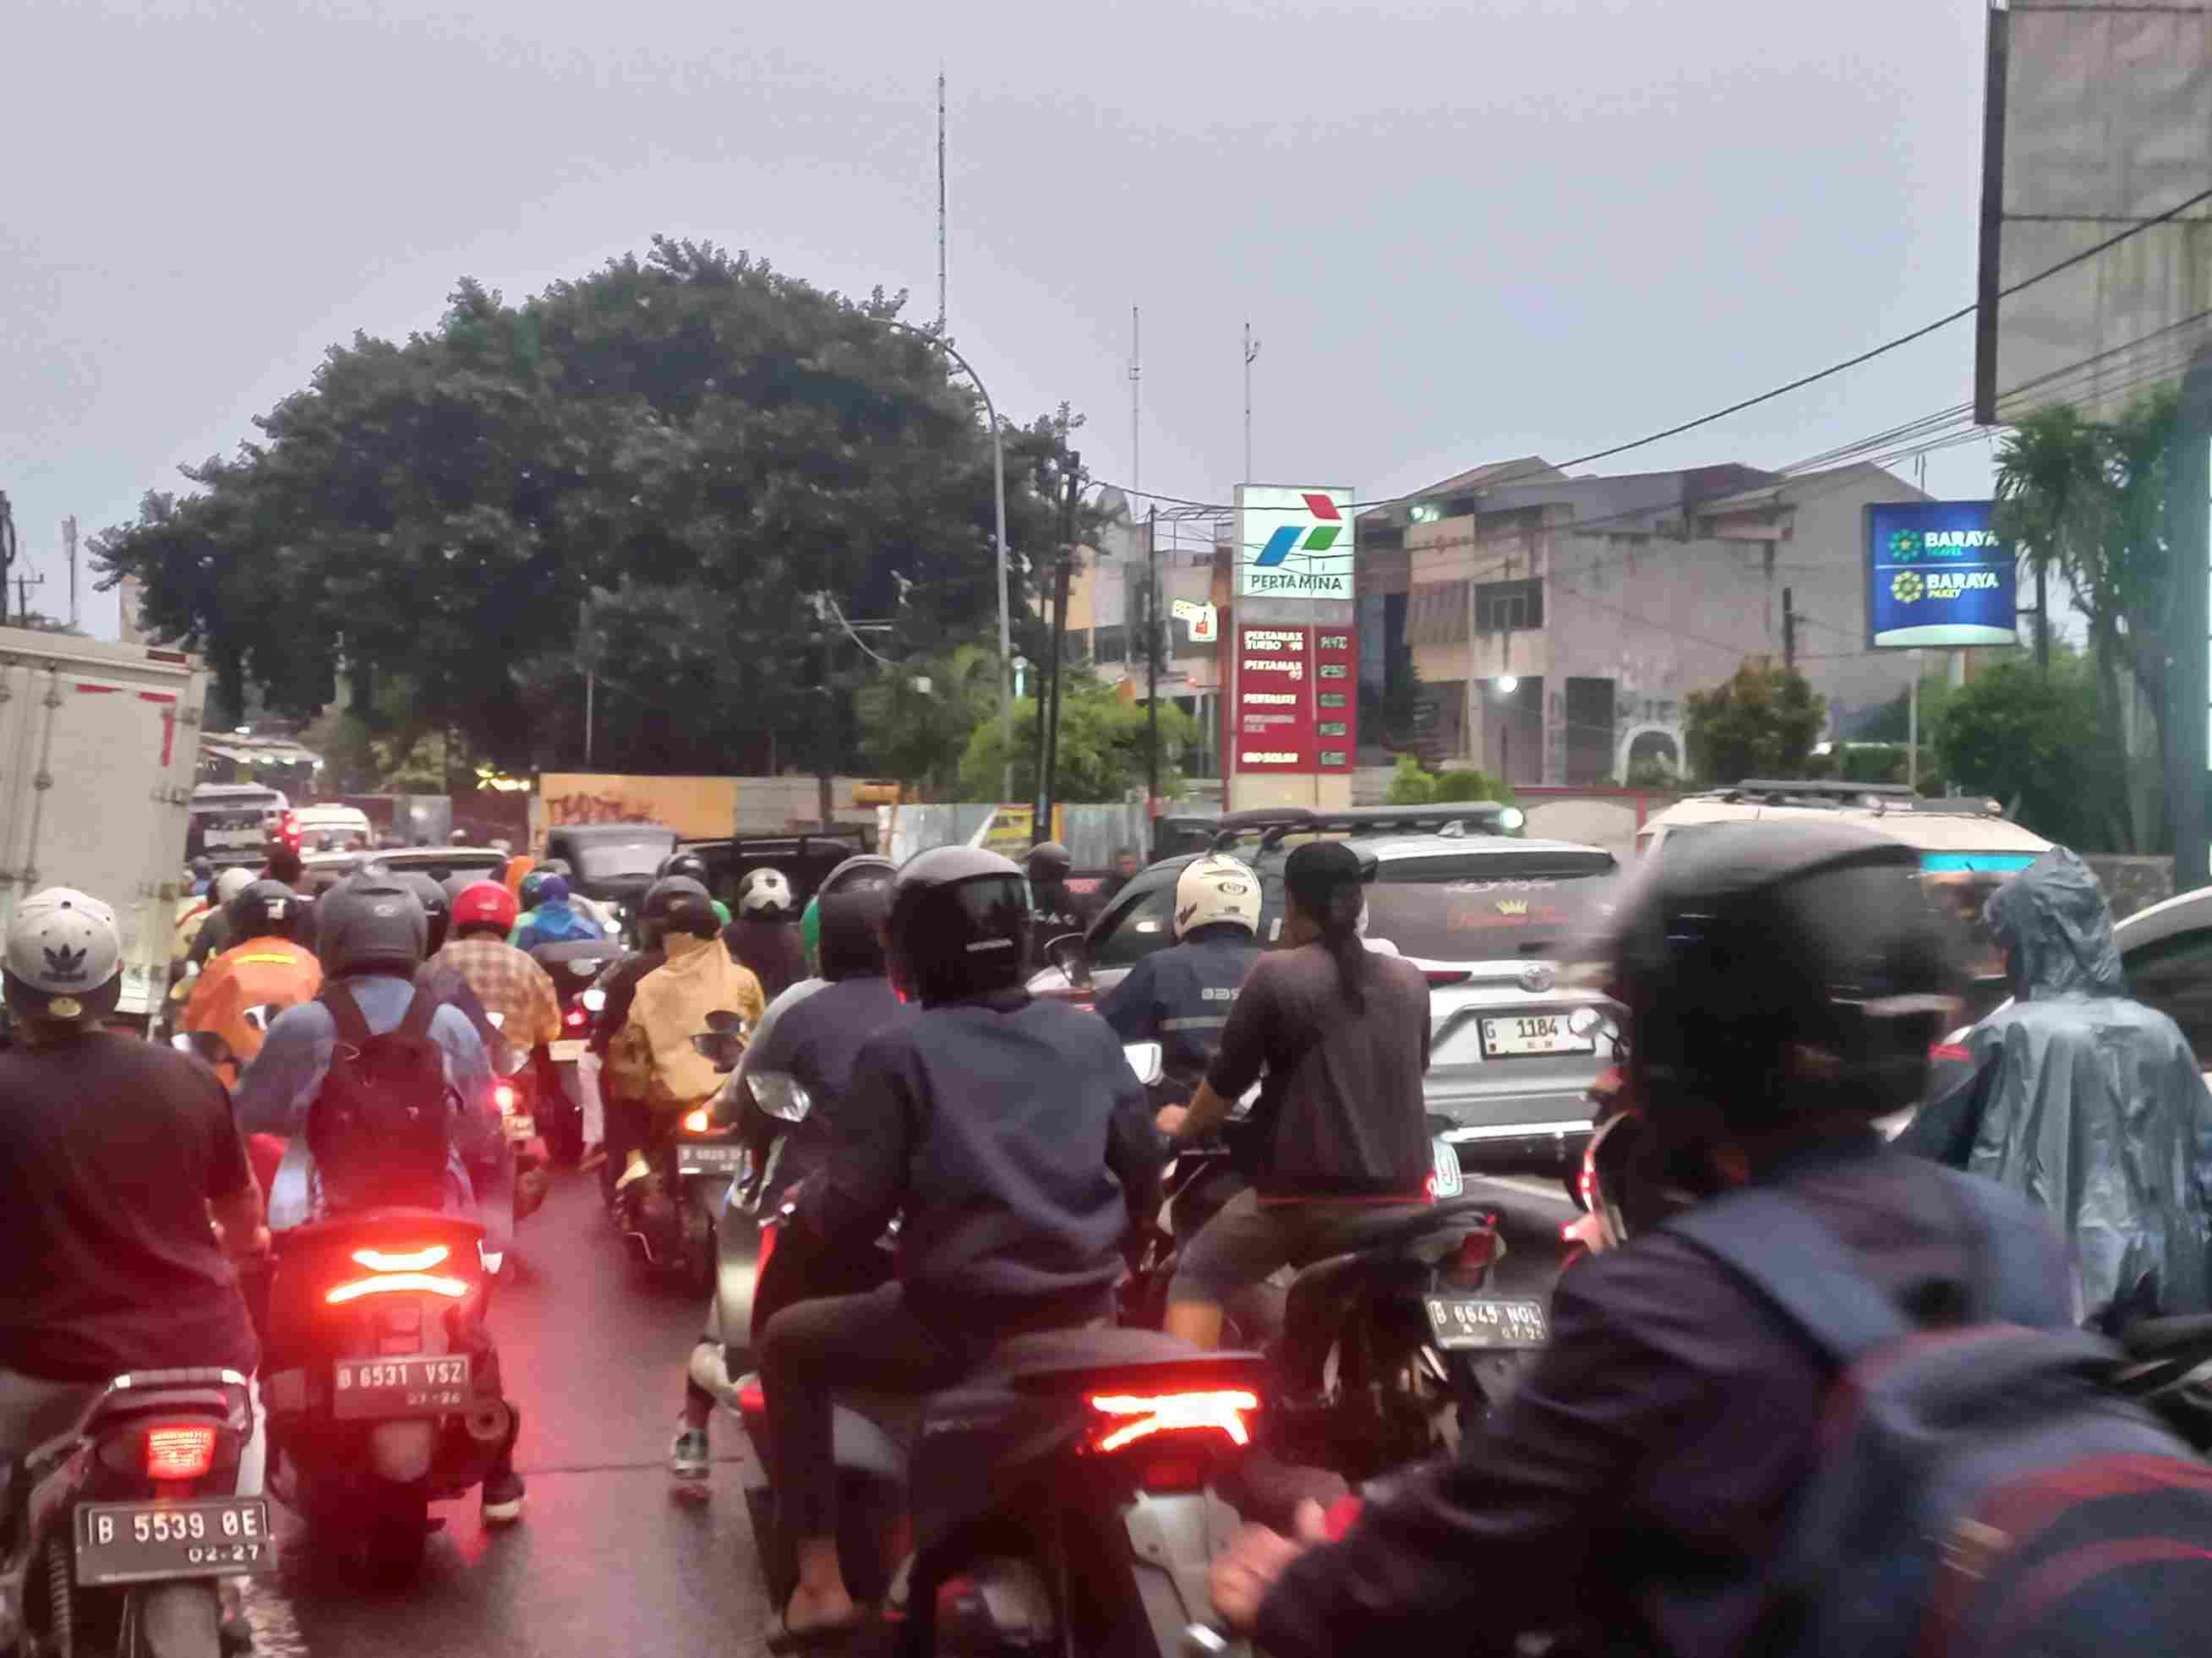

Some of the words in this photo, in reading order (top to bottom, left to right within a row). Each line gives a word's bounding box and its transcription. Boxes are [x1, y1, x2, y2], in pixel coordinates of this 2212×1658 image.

[1925, 531, 1999, 548] BARAYA
[1251, 575, 1342, 590] PERTAMINA
[1926, 573, 2000, 589] BARAYA
[1243, 660, 1303, 670] PERTAMAX
[1484, 1021, 1495, 1039] G
[1516, 1018, 1558, 1038] 1184
[359, 1364, 407, 1388] 6531
[426, 1361, 462, 1384] VSZ
[97, 1516, 114, 1544] B
[134, 1512, 205, 1542] 5539
